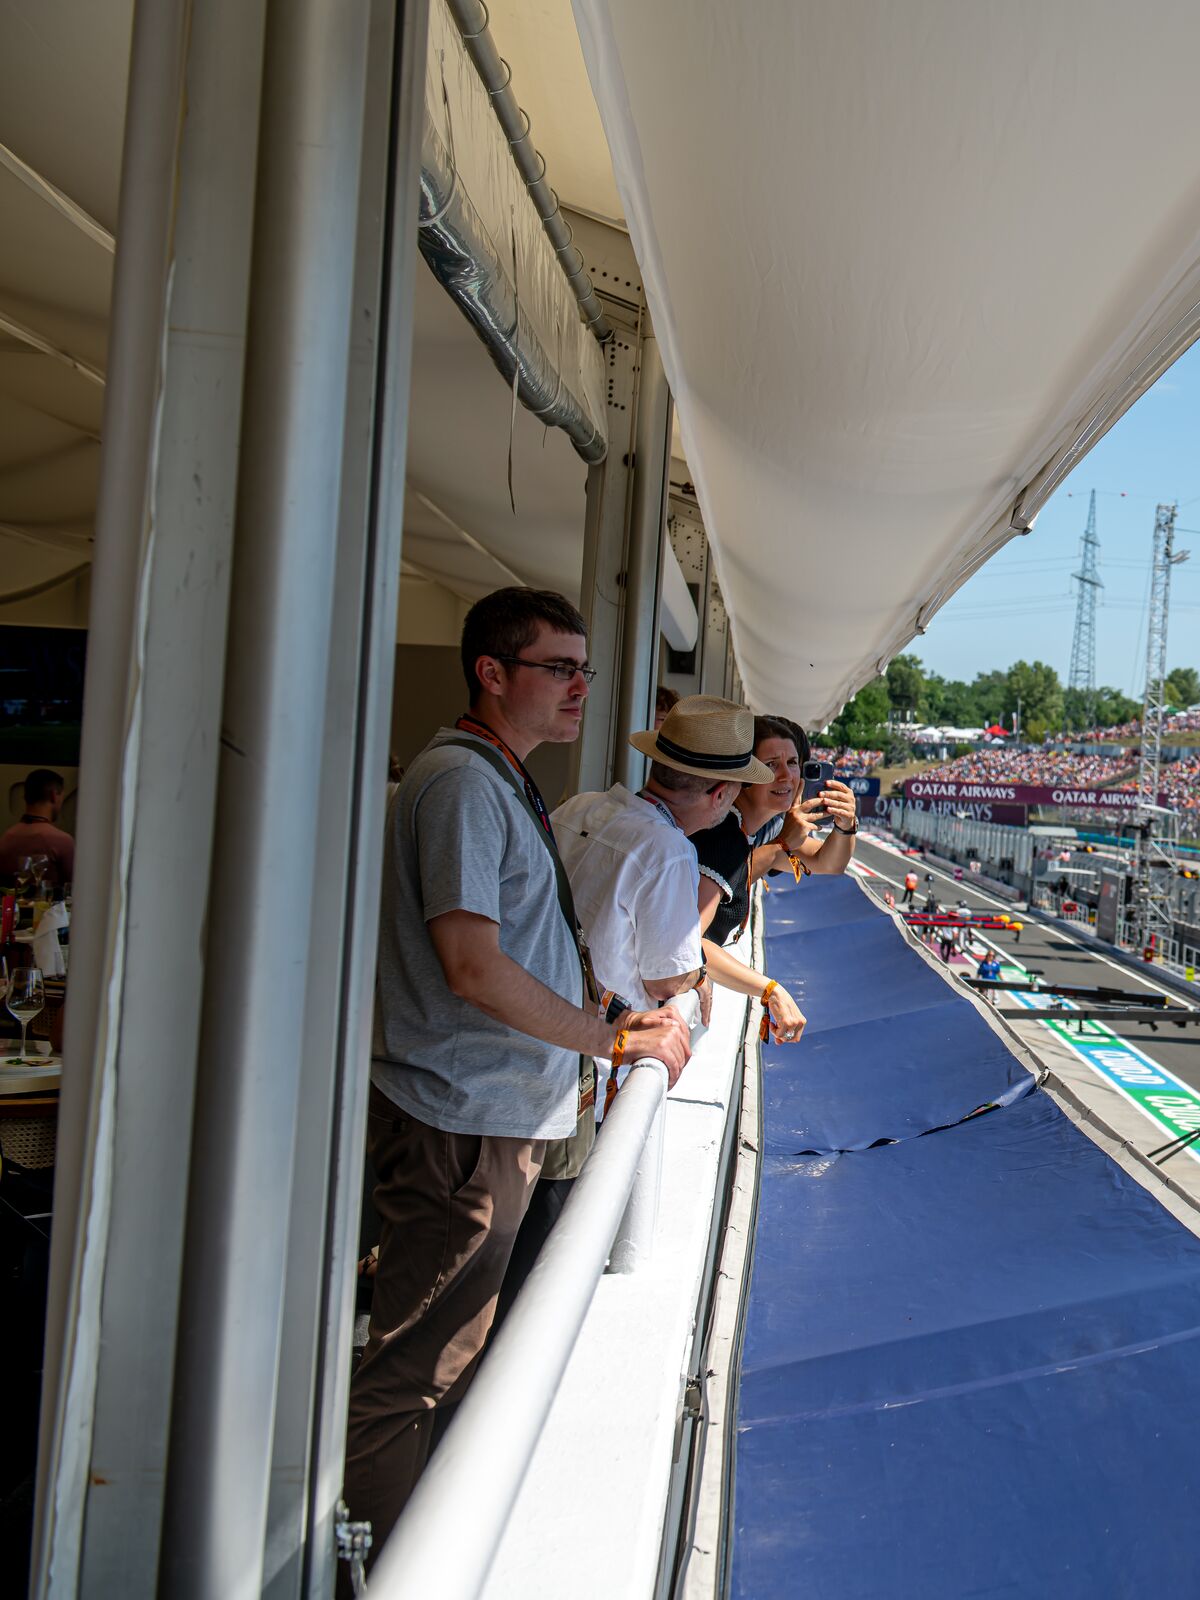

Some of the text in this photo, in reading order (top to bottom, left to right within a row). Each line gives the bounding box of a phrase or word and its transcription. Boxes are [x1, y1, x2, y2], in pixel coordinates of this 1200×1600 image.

[911, 782, 1016, 800] QATAR AIRWAYS
[1052, 790, 1096, 804] QATAR
